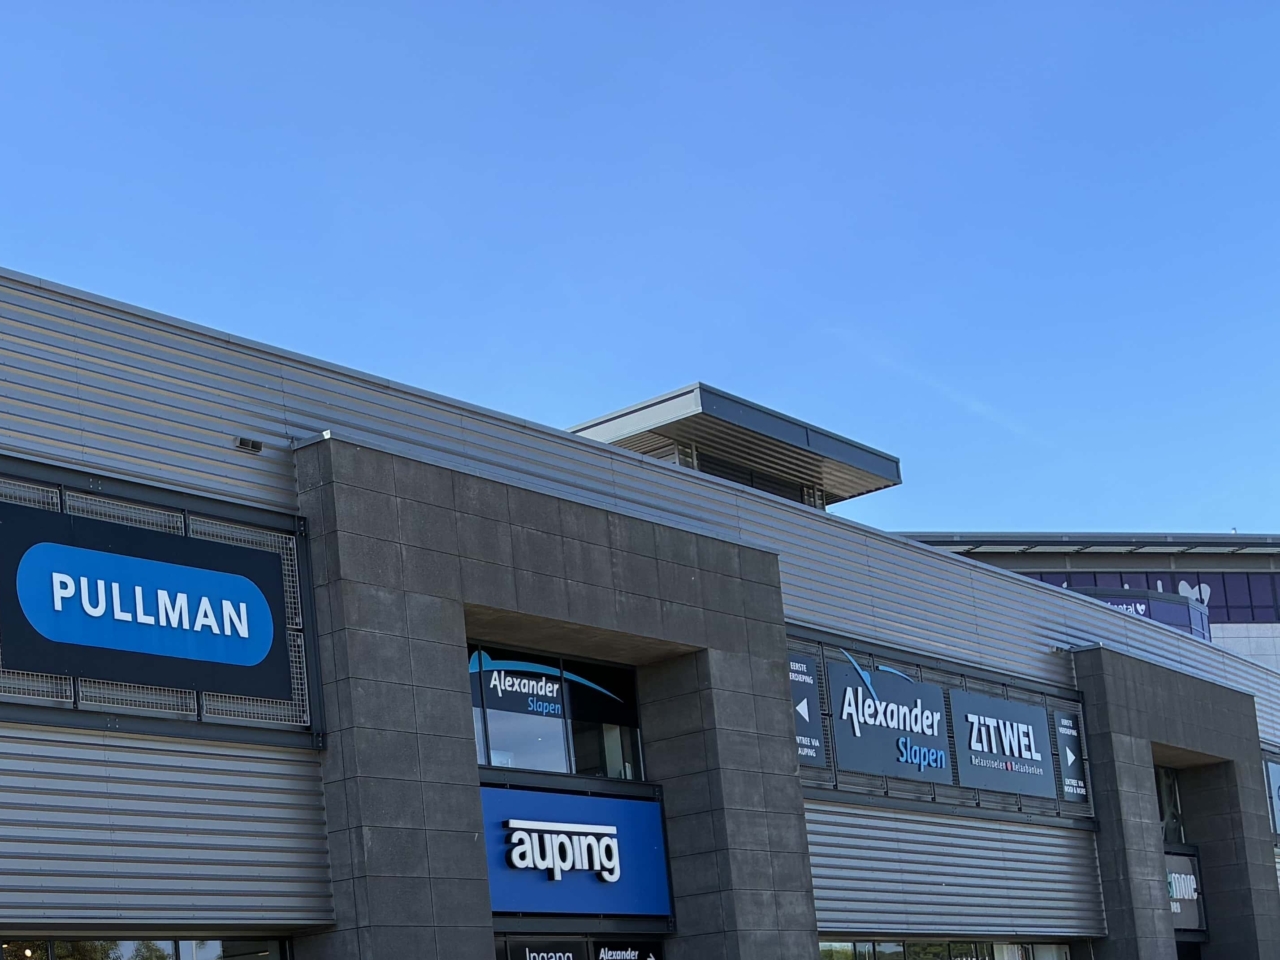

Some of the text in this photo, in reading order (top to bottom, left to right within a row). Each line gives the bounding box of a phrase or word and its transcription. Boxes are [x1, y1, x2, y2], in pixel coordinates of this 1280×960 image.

[51, 572, 250, 639] PULLMAN
[489, 670, 560, 697] Alexander
[789, 672, 814, 684] ERDIEPING
[527, 697, 562, 715] Slapen
[842, 686, 941, 737] Alexander
[795, 735, 811, 746] NTREE
[898, 736, 946, 772] Slapen
[509, 819, 621, 882] auping
